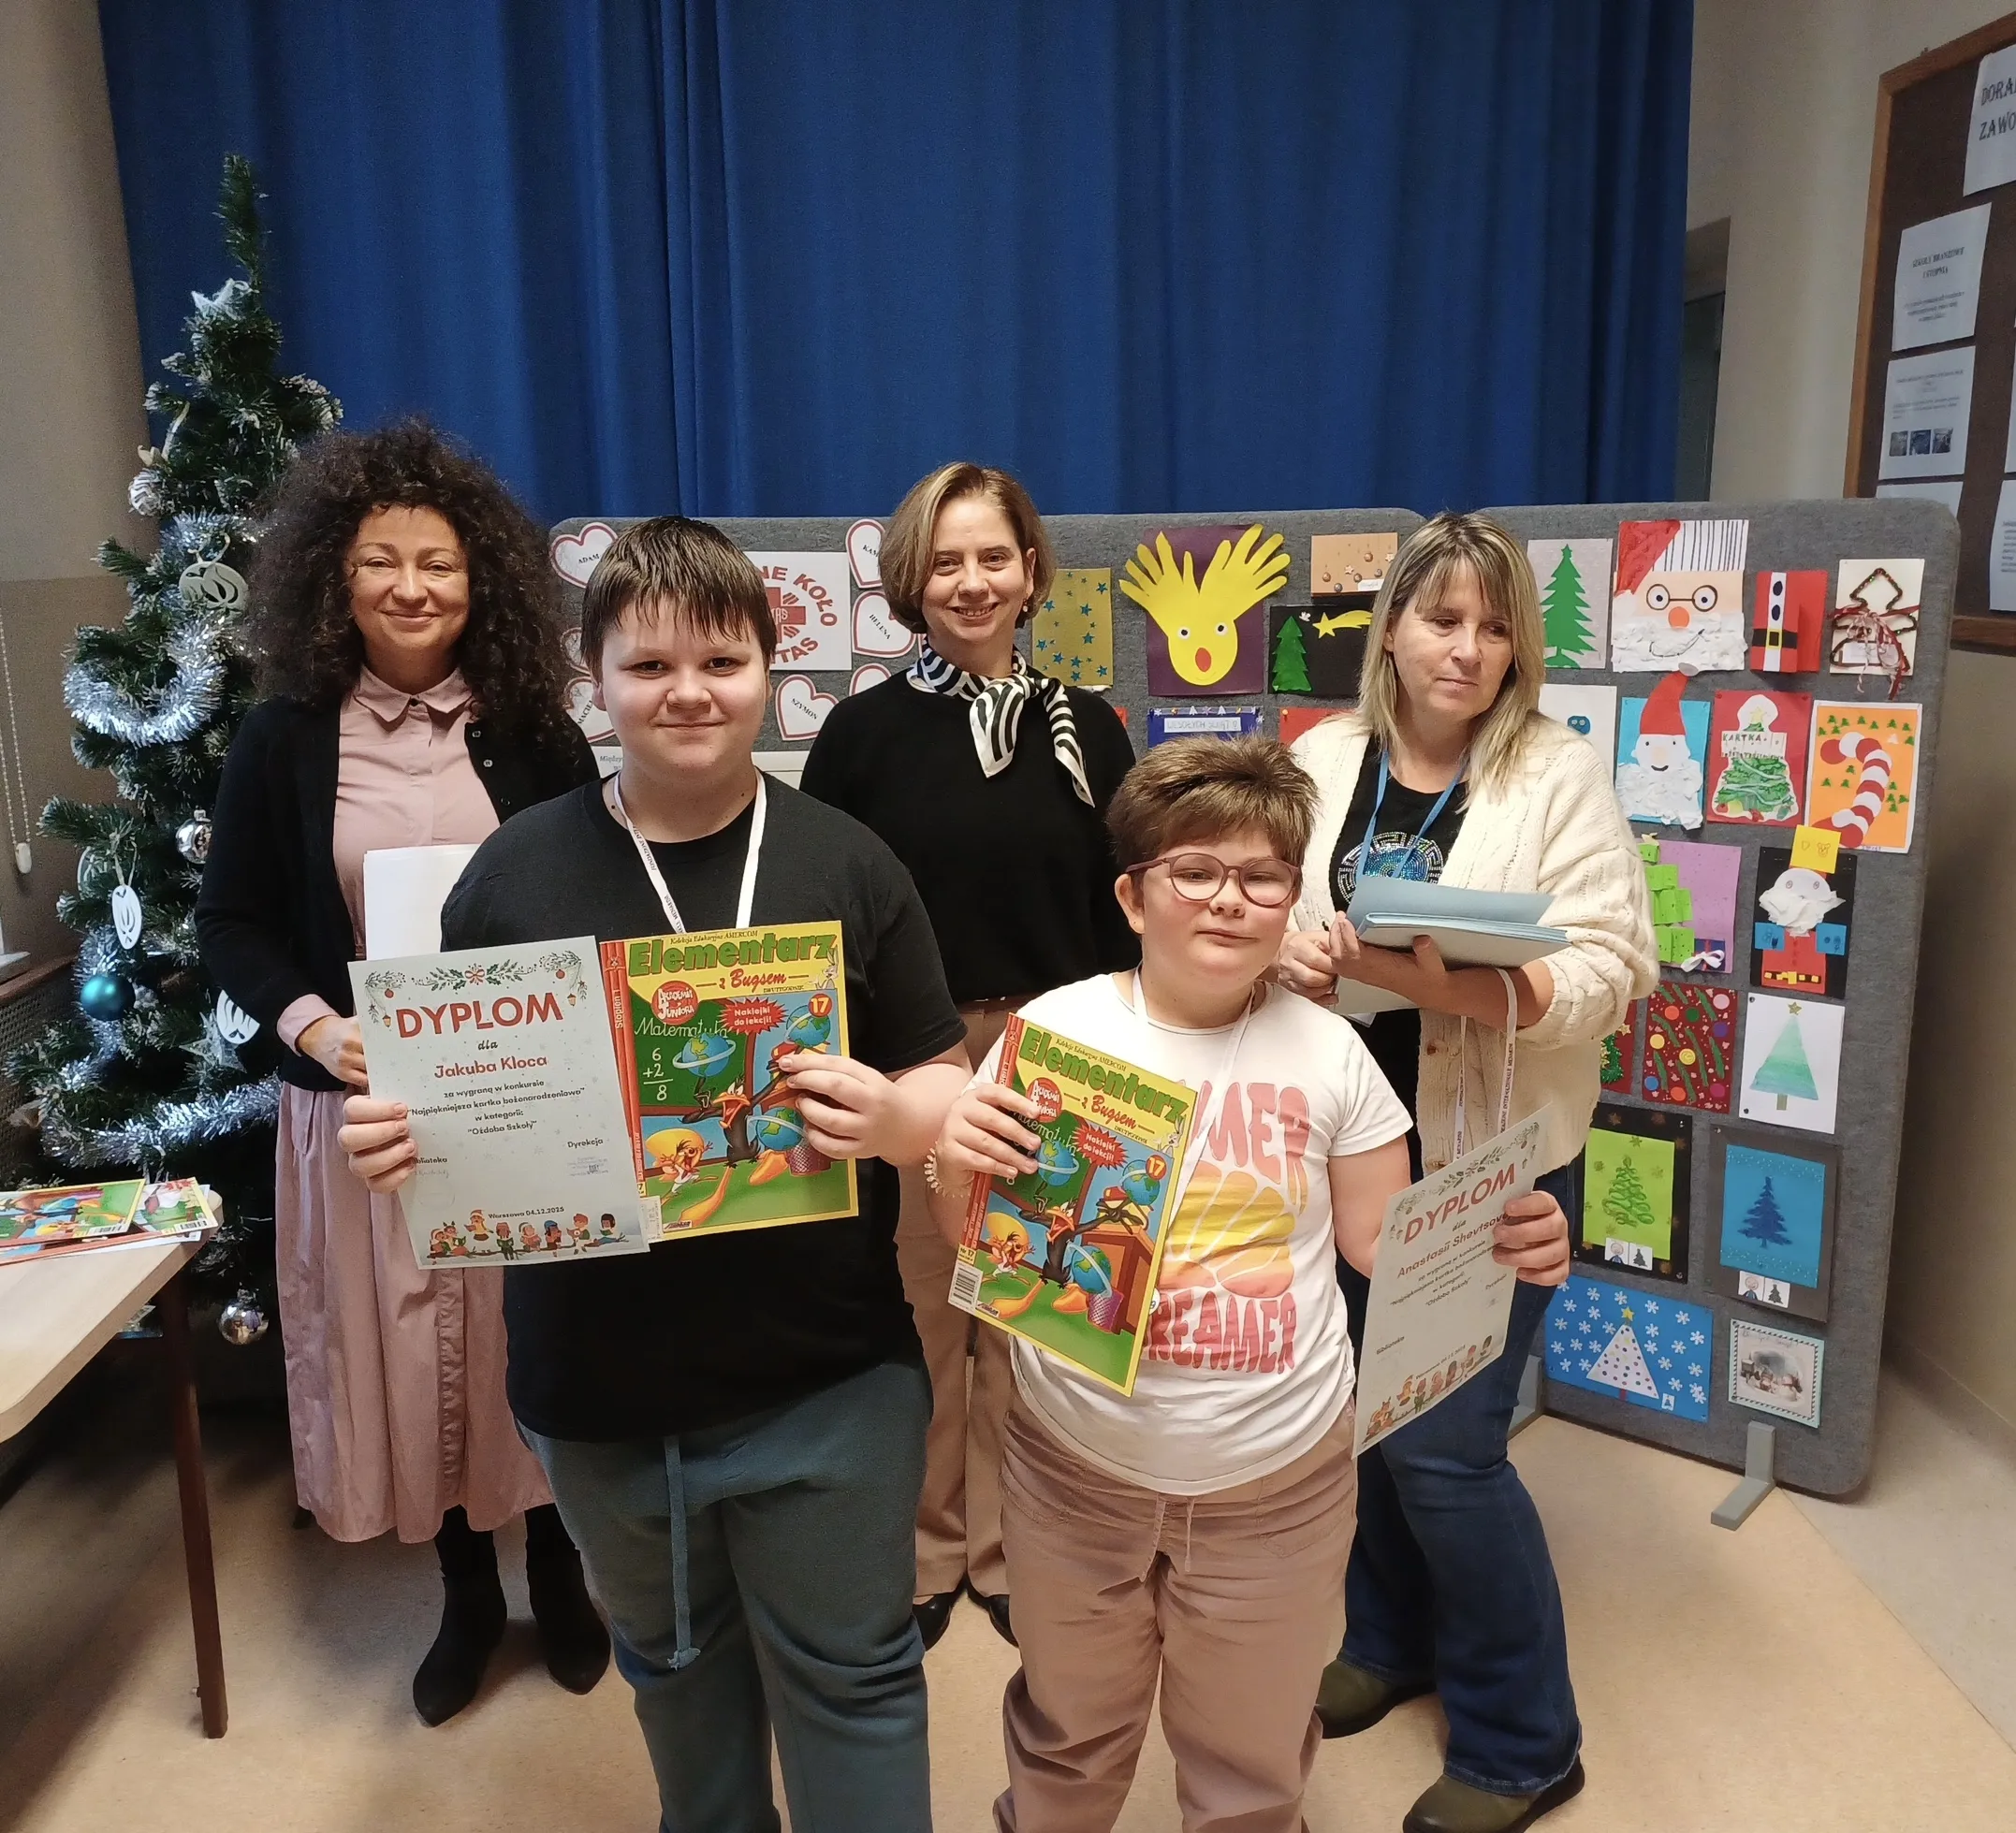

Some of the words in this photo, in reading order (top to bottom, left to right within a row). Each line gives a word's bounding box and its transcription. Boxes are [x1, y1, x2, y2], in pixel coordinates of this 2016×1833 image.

[1981, 78, 2016, 106] DORA
[1979, 111, 2016, 141] ZAWO
[578, 553, 600, 563] ADAM
[863, 545, 878, 558] KAM
[793, 574, 838, 626] KOŁO
[869, 614, 891, 640] HELENA
[769, 637, 819, 664] ITAS
[791, 698, 817, 720] SZYMON
[628, 934, 838, 978] Elementarz
[729, 968, 787, 994] Bugsem
[734, 1006, 770, 1017] Naklejki
[810, 997, 829, 1013] 17
[396, 992, 563, 1039] DYPLOM
[734, 1018, 743, 1026] do
[745, 1015, 772, 1026] lekcji!
[477, 1040, 499, 1051] dla
[651, 1047, 662, 1061] 6
[433, 1060, 497, 1079] Jakuba
[500, 1055, 548, 1070] Kloca
[643, 1063, 665, 1078] +2
[1019, 1026, 1190, 1125] Elementarz
[456, 1087, 493, 1098] wygraną
[504, 1080, 545, 1091] konkursie
[656, 1084, 667, 1101] 8
[474, 1098, 502, 1109] kartka
[1091, 1094, 1137, 1130] Bugsem
[484, 1109, 524, 1120] kategorii:
[566, 1137, 604, 1149] Dyrekcja
[1013, 1112, 1076, 1157] atematyka
[1086, 1133, 1116, 1152] Naklejki
[1083, 1142, 1092, 1151] do
[1093, 1145, 1115, 1162] lekcji!
[1187, 1081, 1311, 1216] MER
[416, 1156, 448, 1164] blioteka
[1148, 1157, 1165, 1177] 17
[526, 1206, 565, 1217] 04.12.2025
[1403, 1162, 1515, 1245] DYPLOM
[1453, 1219, 1467, 1232] dla
[968, 1249, 974, 1258] 17
[1397, 1241, 1451, 1279] Anastasii
[1453, 1213, 1508, 1247] Shevtsov
[1148, 1289, 1297, 1375] REAMER
